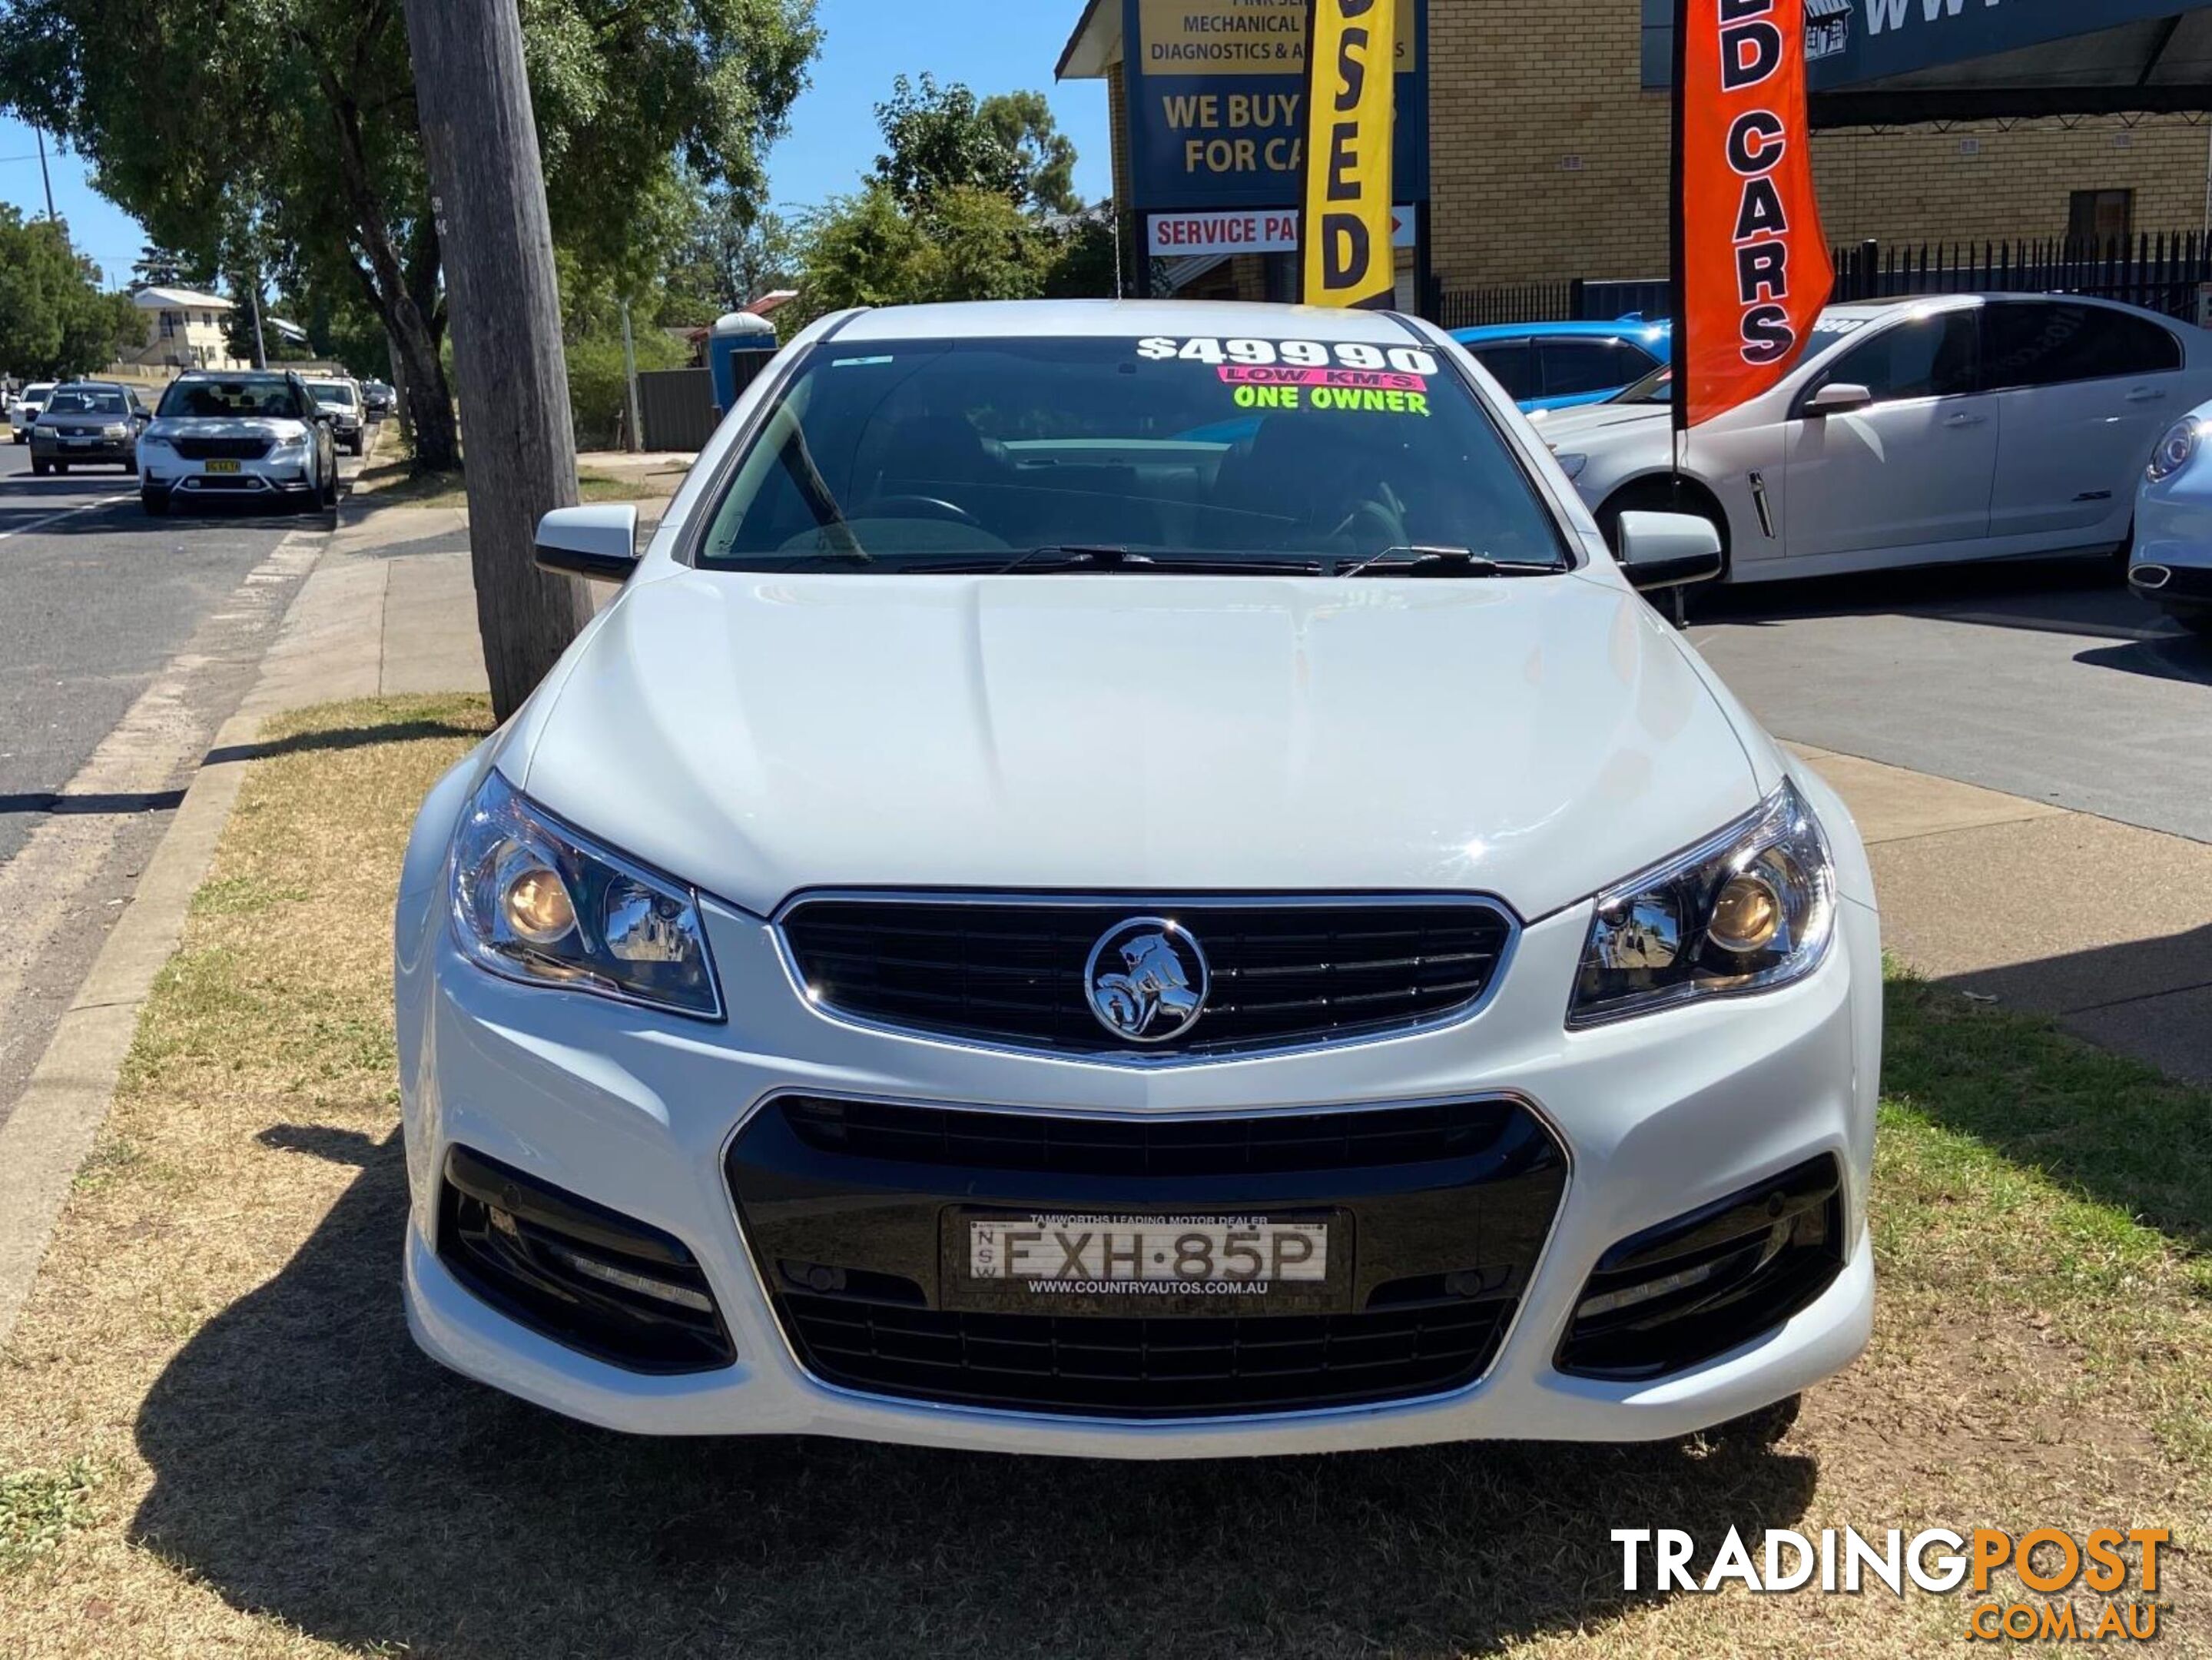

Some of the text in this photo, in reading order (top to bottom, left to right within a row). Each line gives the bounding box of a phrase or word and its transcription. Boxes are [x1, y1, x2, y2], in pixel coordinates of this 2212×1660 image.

[1184, 15, 1300, 32] MECHANICAL
[1152, 43, 1271, 60] DIAGNOSTICS
[1275, 44, 1287, 59] &
[1162, 94, 1301, 129] WE BUY
[1186, 139, 1256, 172] FOR
[1322, 0, 1373, 289] SED
[1157, 218, 1257, 245] SERVICE
[1726, 109, 1796, 366] CARS
[1136, 337, 1438, 375] $49990
[1225, 367, 1307, 382] LOW
[1234, 385, 1432, 417] ONE OWNER
[1113, 1214, 1166, 1225] LEADING
[1169, 1215, 1215, 1225] MOTOR
[1219, 1215, 1268, 1226] DEALER
[1029, 1280, 1269, 1295] WWW.COUNTRYAUTOS.COM.AU
